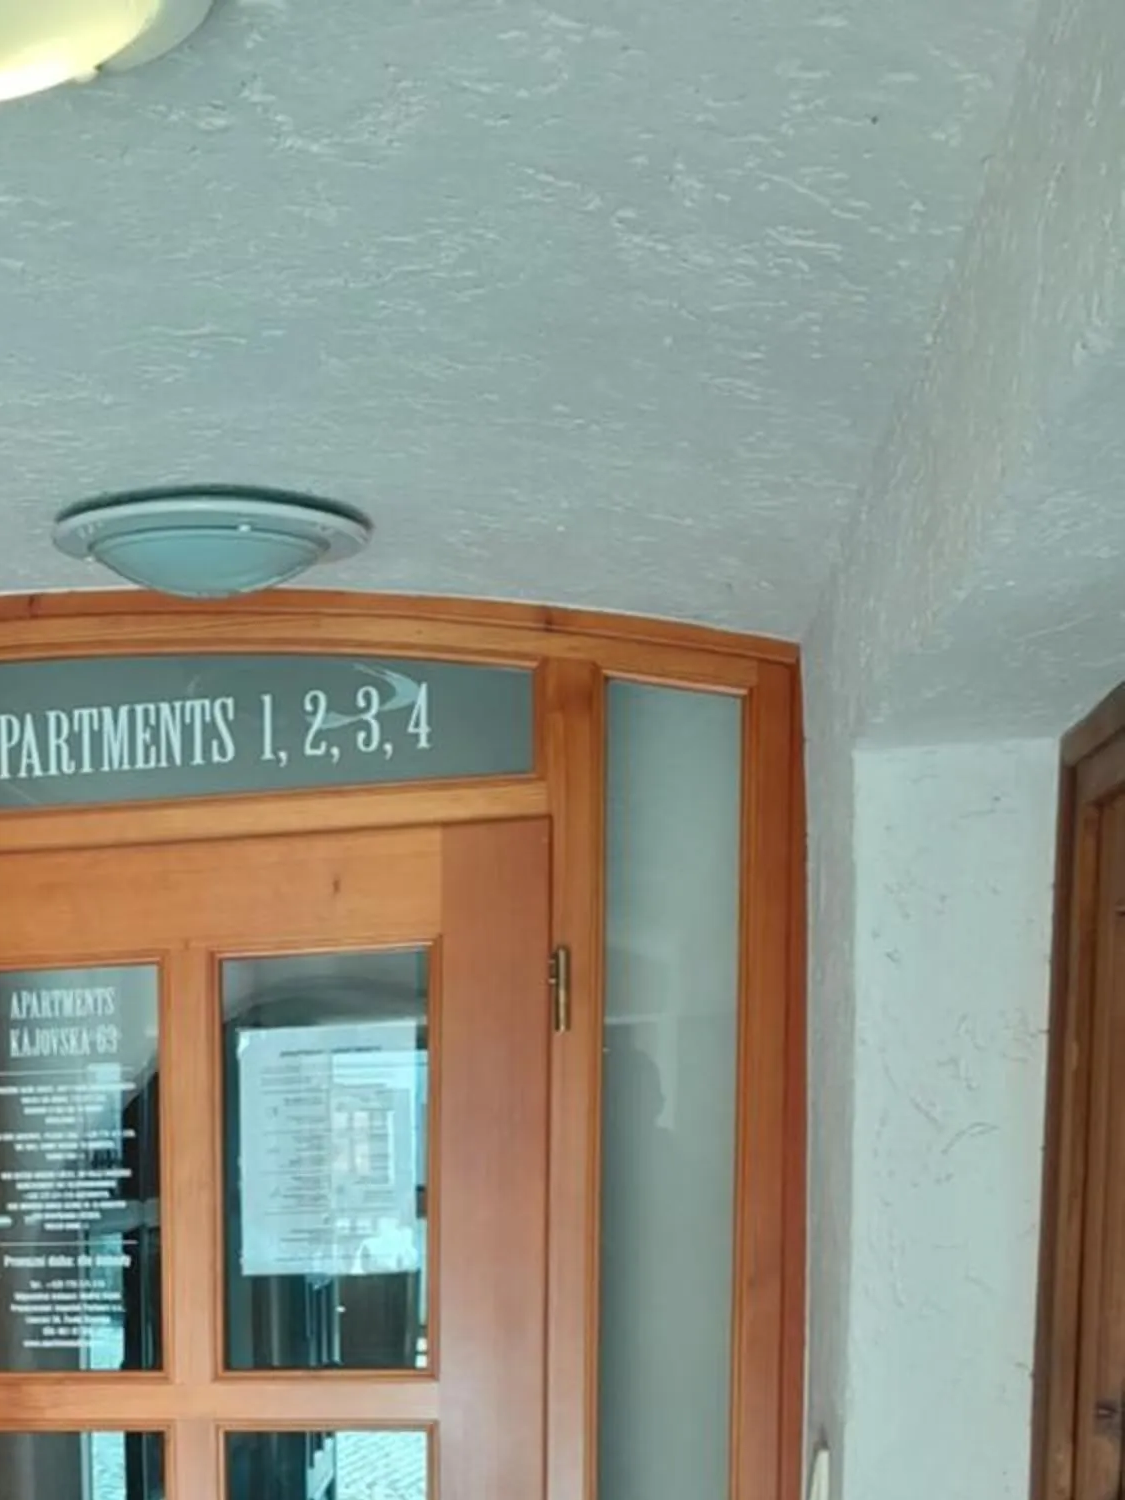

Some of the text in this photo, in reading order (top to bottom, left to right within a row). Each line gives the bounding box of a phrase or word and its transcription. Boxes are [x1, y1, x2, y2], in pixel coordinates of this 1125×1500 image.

[259, 693, 289, 767] 1,
[303, 690, 341, 765] 2,
[356, 685, 394, 759] 3,
[407, 681, 432, 750] 4
[10, 987, 116, 1021] APARTMENTS
